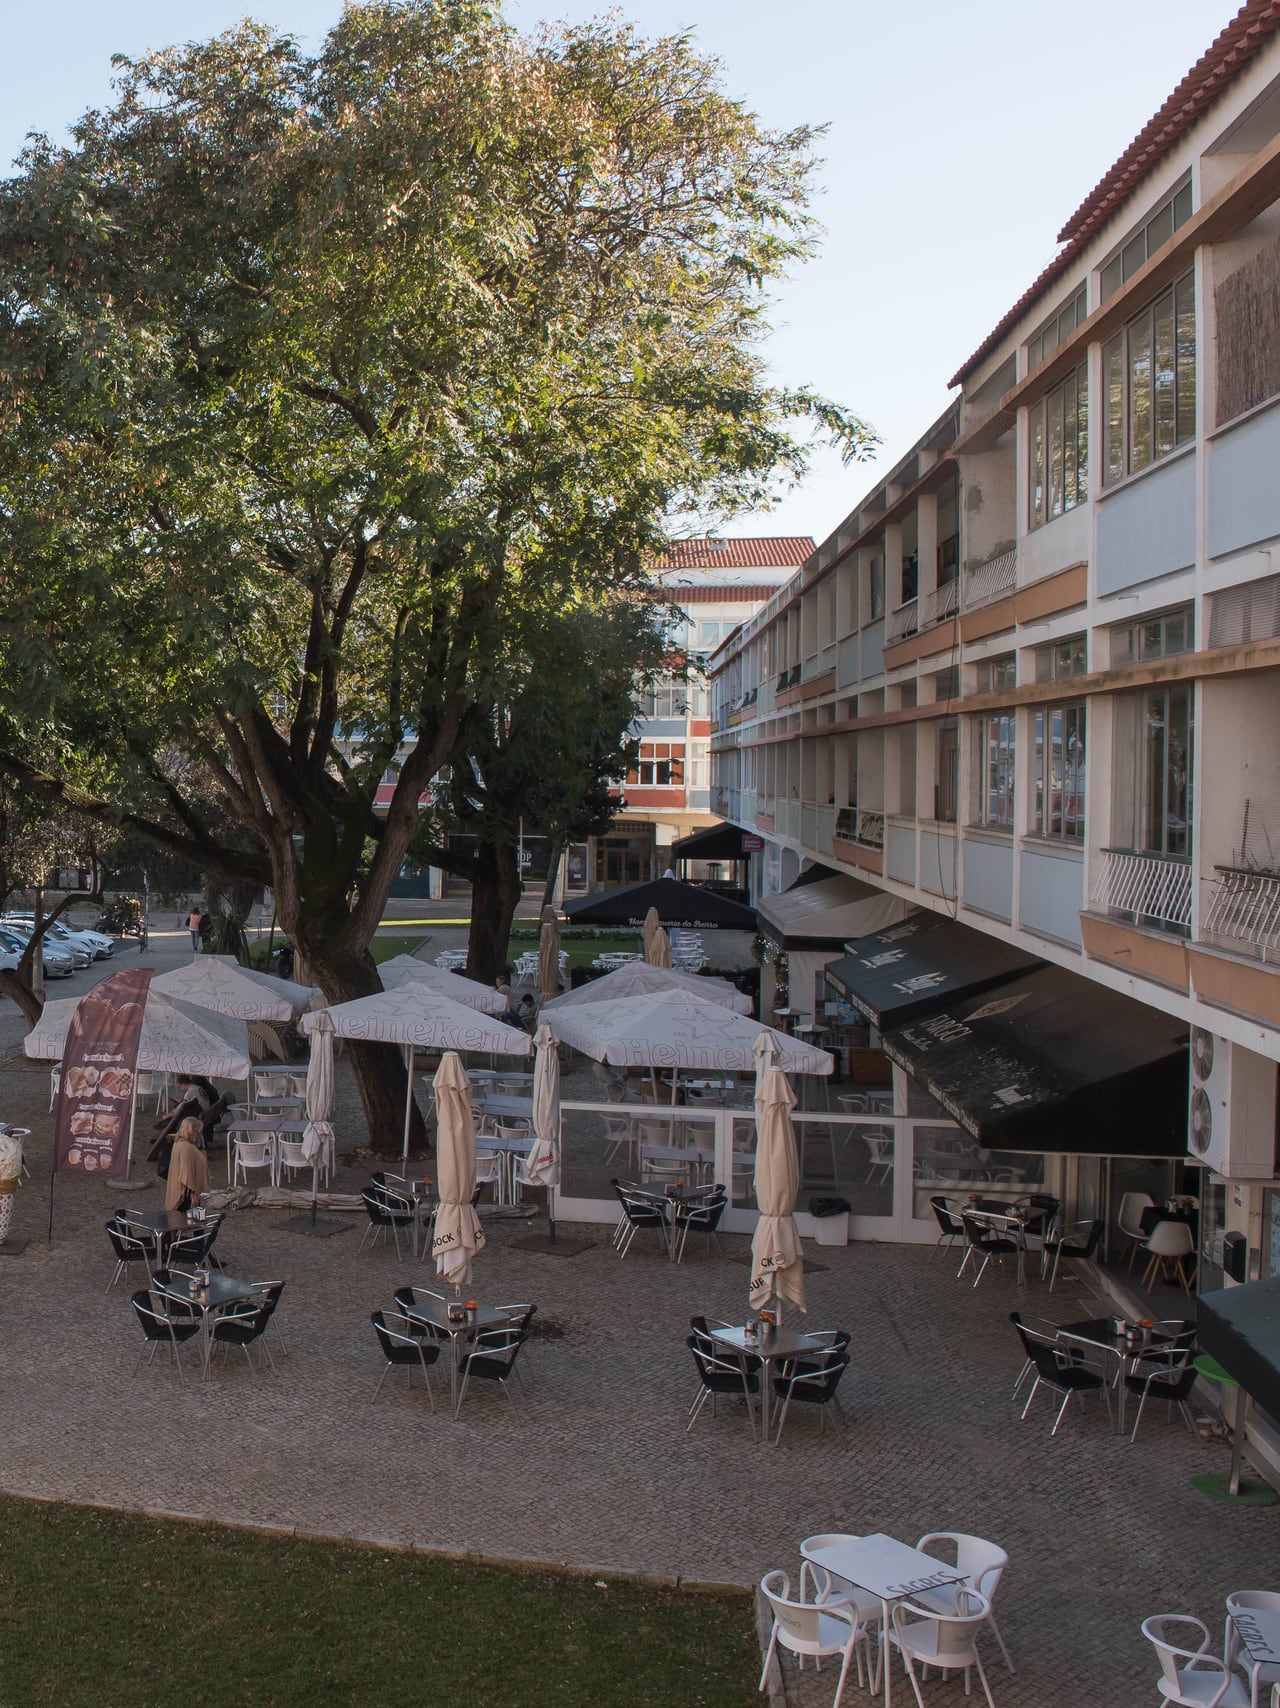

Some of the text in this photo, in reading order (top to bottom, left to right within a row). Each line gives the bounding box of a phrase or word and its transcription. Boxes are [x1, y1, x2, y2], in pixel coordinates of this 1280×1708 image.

[35, 1032, 234, 1074] Heken
[622, 1038, 818, 1075] Heineen
[761, 1257, 774, 1267] CK
[886, 1571, 958, 1595] SAGRES
[1231, 1613, 1275, 1654] SAGRES
